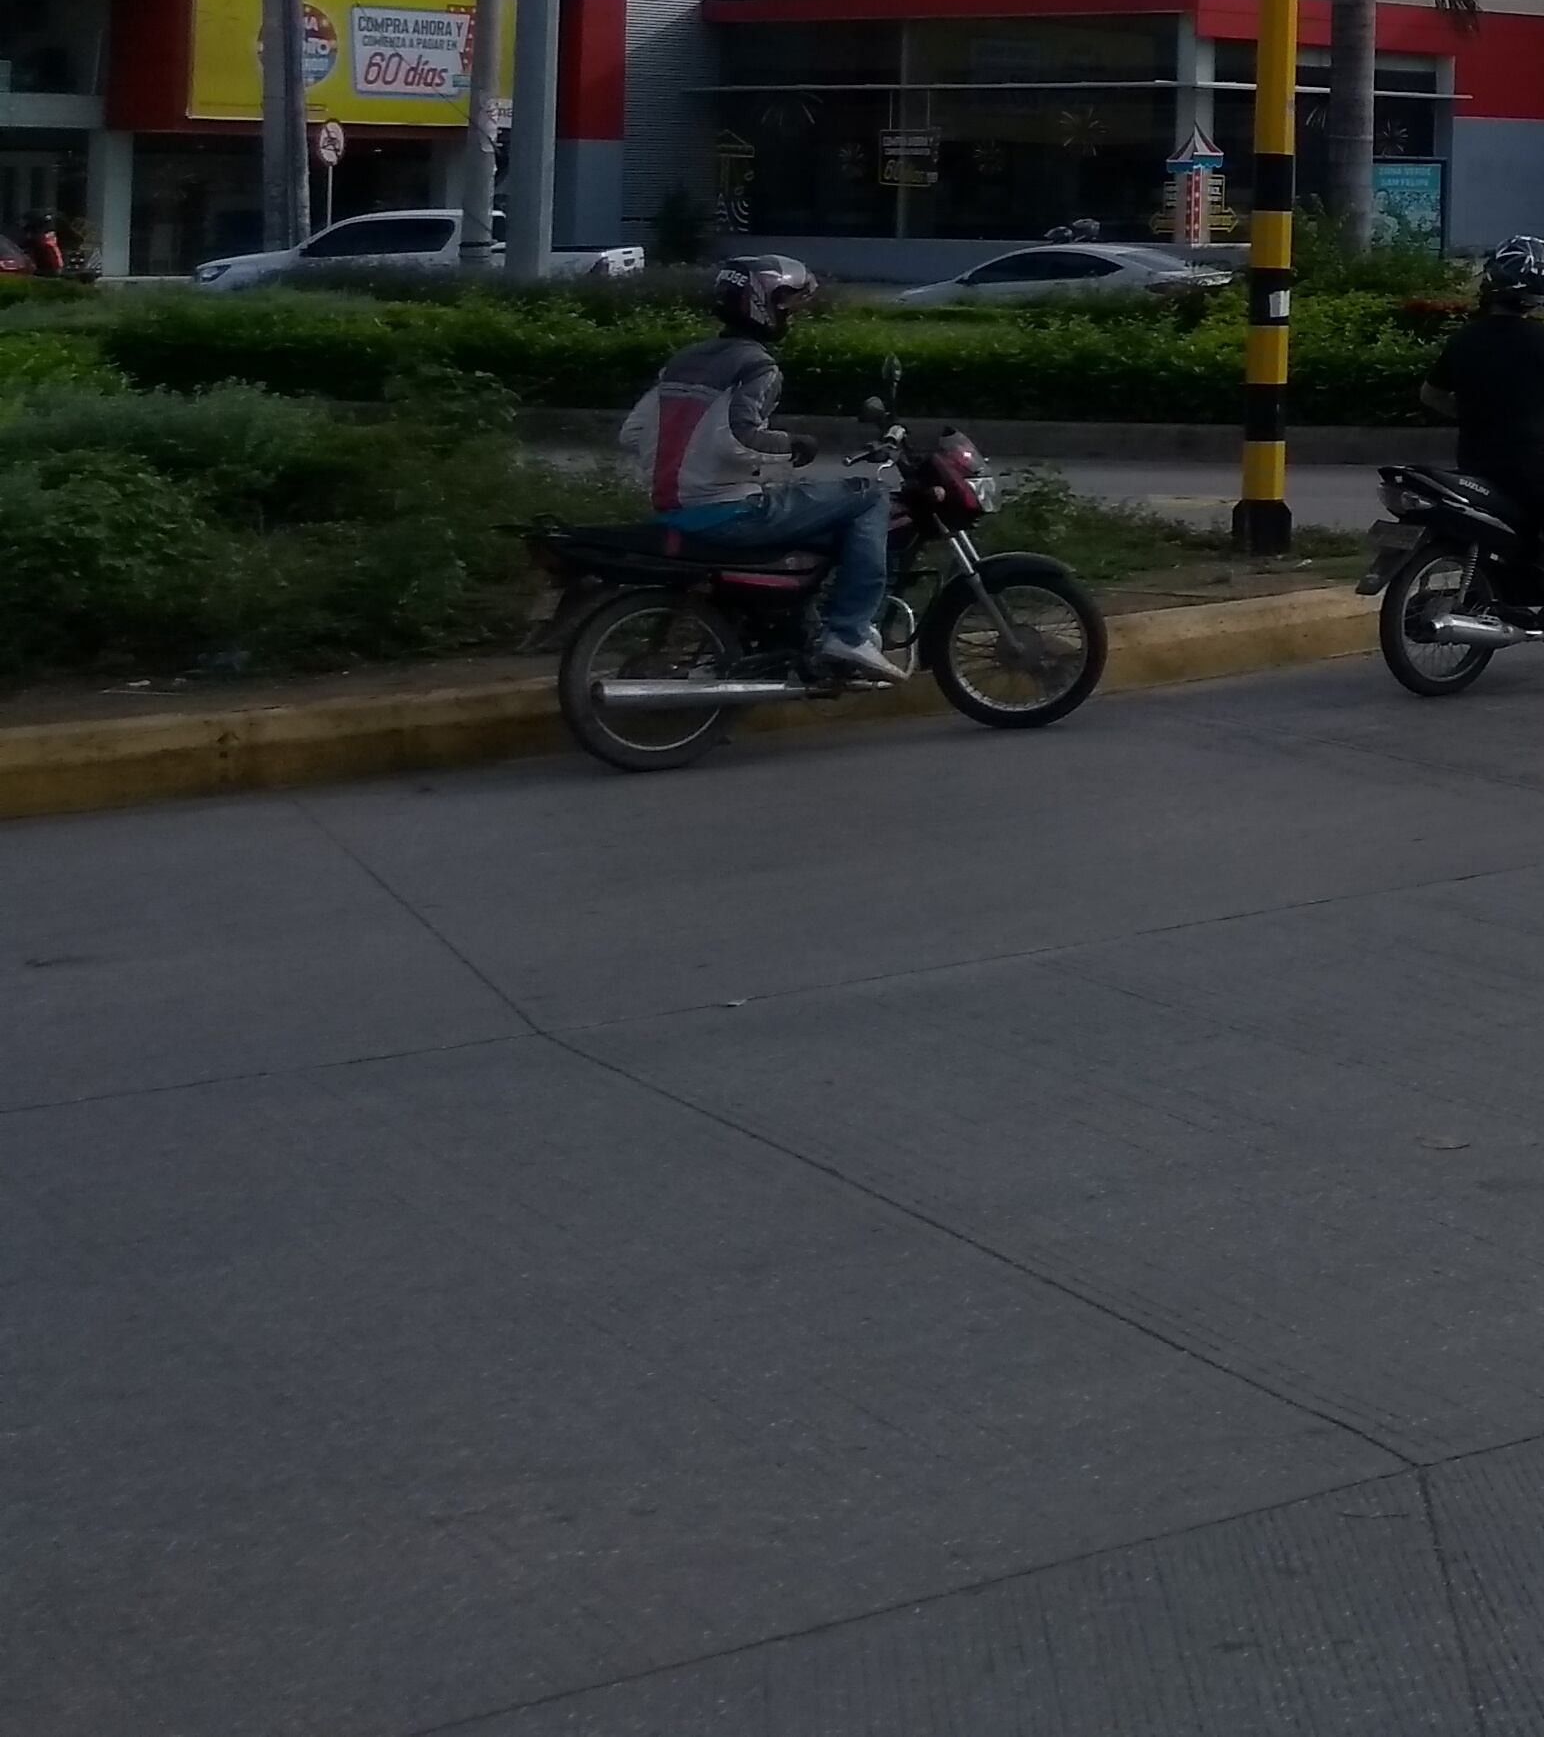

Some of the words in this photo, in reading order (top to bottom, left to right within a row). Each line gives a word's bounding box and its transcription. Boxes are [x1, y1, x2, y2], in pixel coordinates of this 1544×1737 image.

[358, 16, 409, 34] COMPRA
[412, 19, 452, 36] AHORA
[455, 21, 464, 38] Y
[362, 37, 406, 48] COMIENZA
[408, 38, 415, 48] A
[416, 38, 444, 50] PAGAR
[446, 40, 458, 51] EN
[363, 51, 403, 86] 60
[404, 53, 449, 88] días
